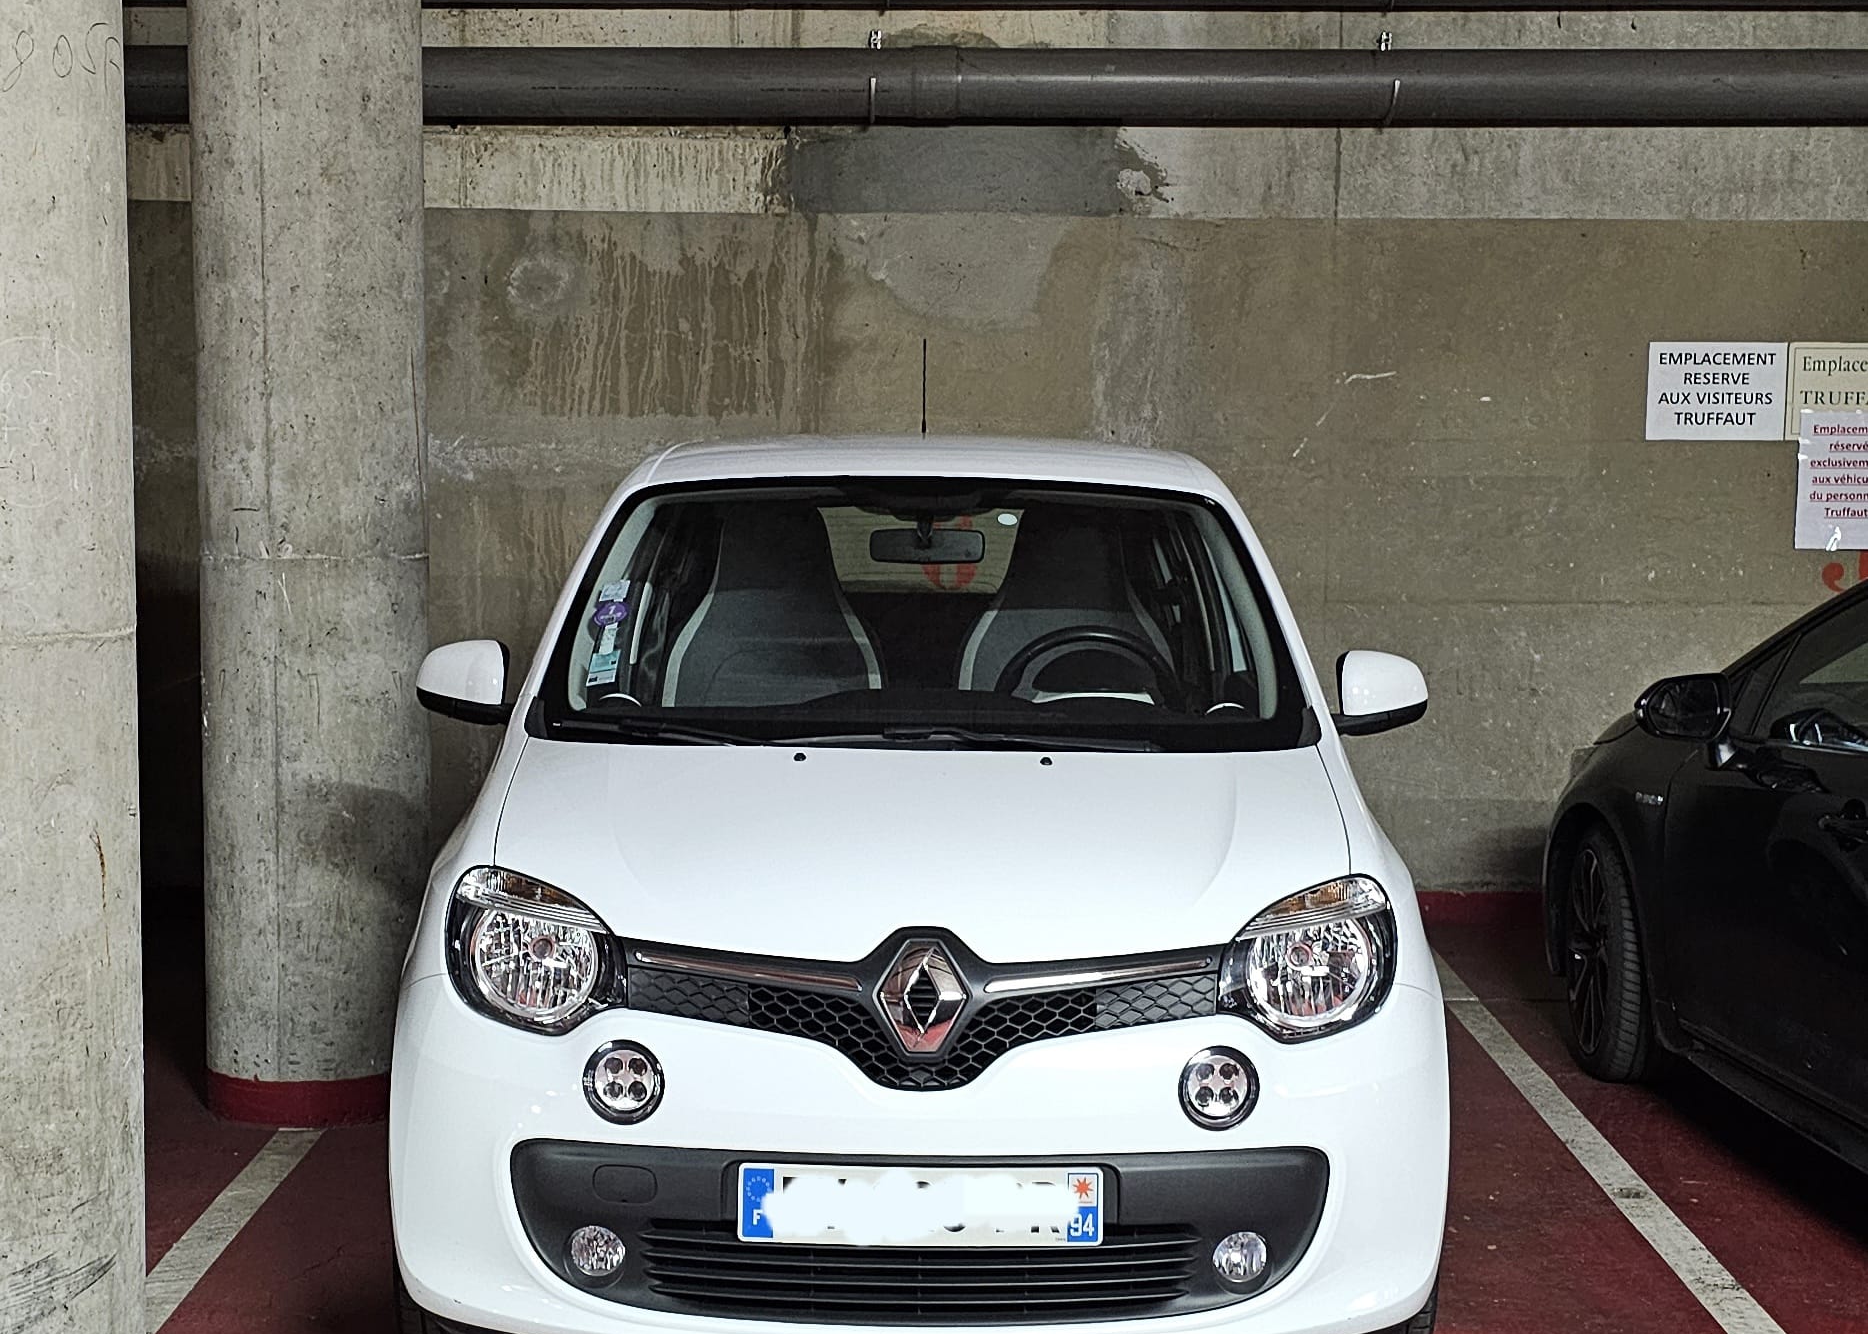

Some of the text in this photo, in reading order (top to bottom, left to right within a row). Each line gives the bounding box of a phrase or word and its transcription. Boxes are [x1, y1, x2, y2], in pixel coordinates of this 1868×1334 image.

[1658, 352, 1777, 367] EMPLACEMENT
[1683, 372, 1750, 385] RESERVE
[1658, 392, 1774, 405] AUX VISITEURS
[1799, 390, 1868, 405] TRUFF
[1674, 412, 1757, 426] TRUFFAUT
[1811, 475, 1831, 484] aux
[1809, 491, 1823, 500] du
[1824, 507, 1868, 517] Truffaut
[752, 1208, 763, 1226] F
[1069, 1212, 1095, 1237] 94
